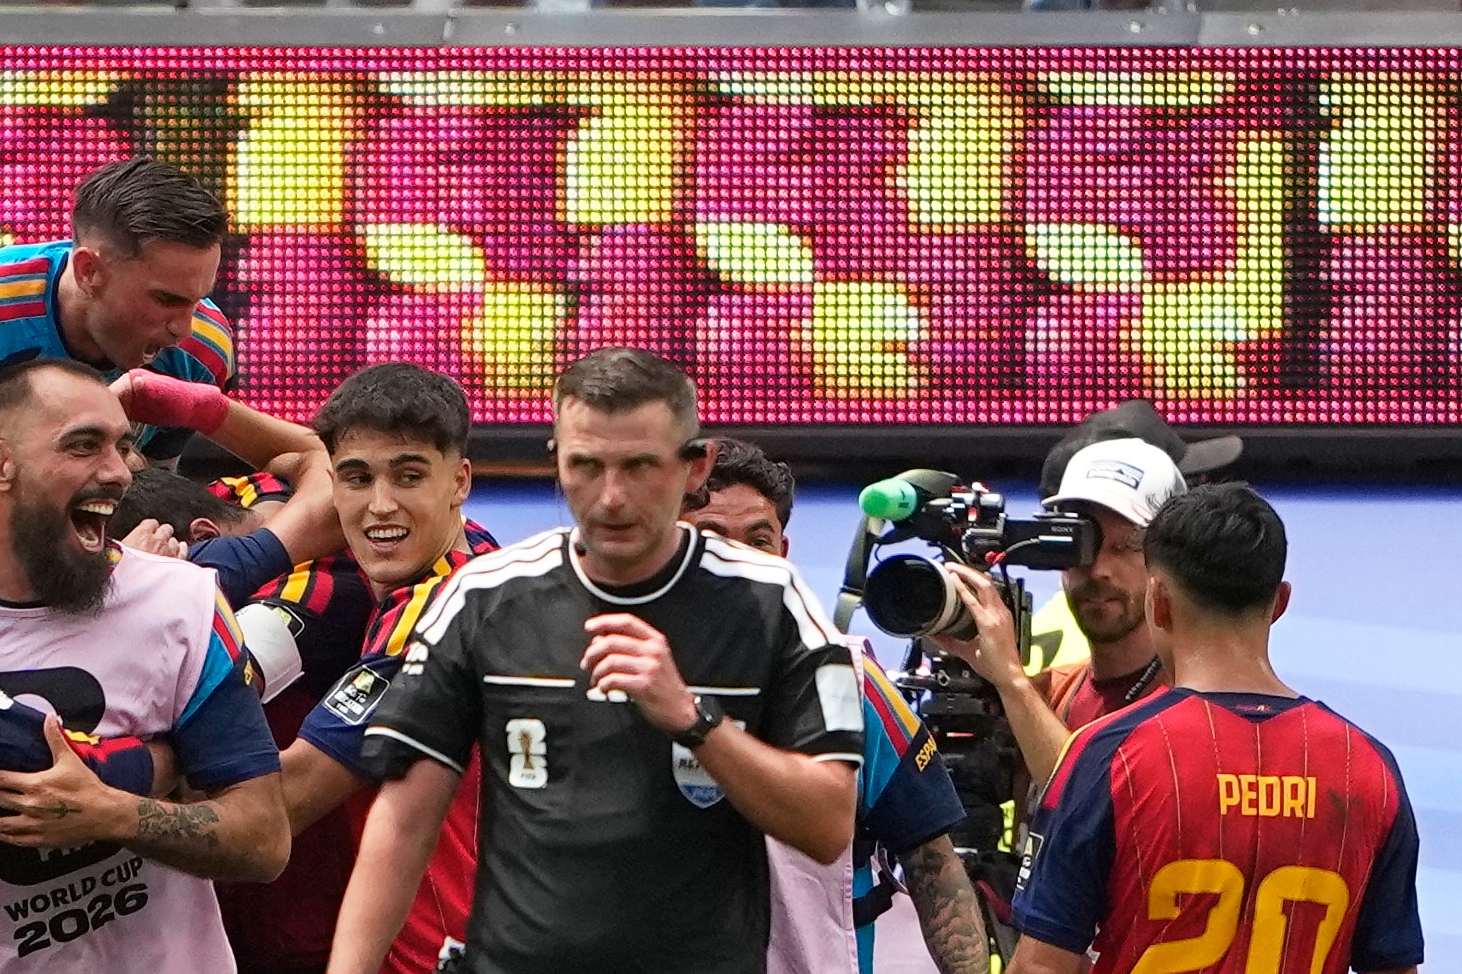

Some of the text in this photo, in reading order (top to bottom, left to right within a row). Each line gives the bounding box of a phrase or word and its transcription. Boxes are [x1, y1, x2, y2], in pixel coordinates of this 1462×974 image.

[1216, 774, 1317, 819] PEDRI
[3, 856, 144, 922] WORLD CUP
[13, 883, 149, 958] 2026
